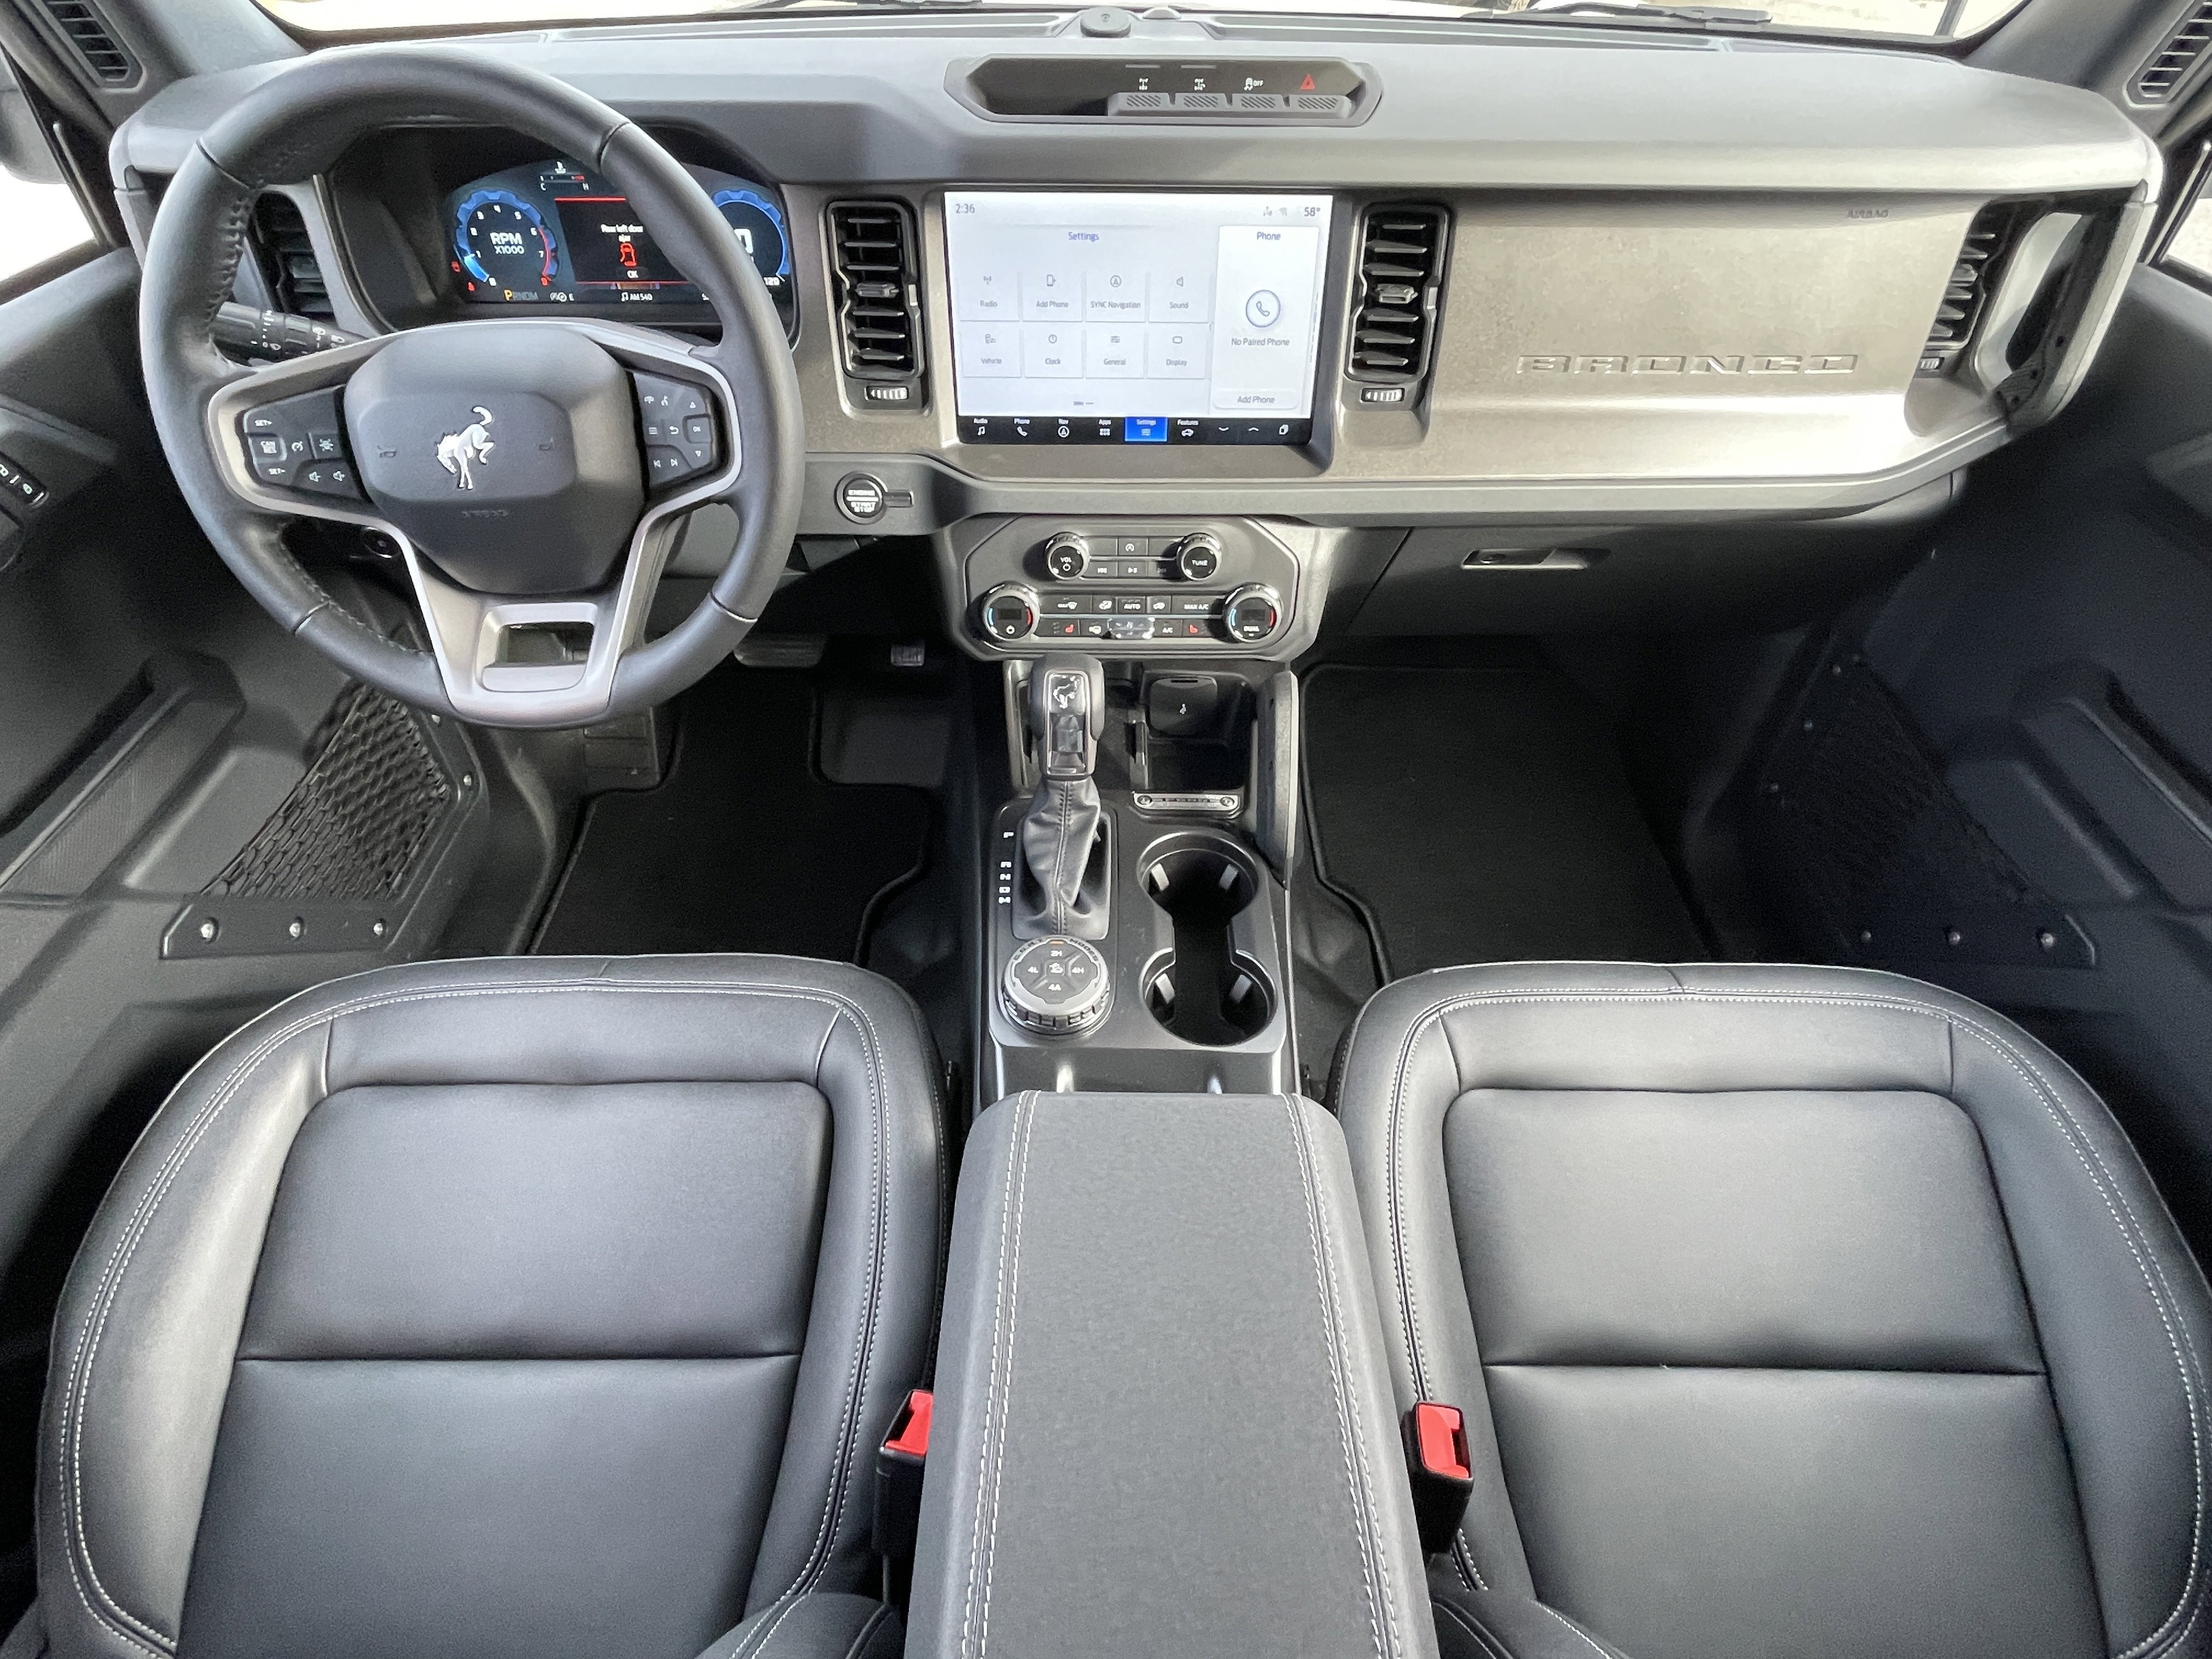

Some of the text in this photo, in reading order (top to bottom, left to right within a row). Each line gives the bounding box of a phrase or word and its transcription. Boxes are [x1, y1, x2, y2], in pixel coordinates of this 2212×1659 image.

[956, 204, 975, 213] 2:36
[490, 232, 523, 245] RPM
[1068, 232, 1099, 242] Settings
[1256, 232, 1281, 240] Phone
[494, 245, 524, 255] X1000
[1108, 301, 1141, 309] Navigation
[1267, 338, 1290, 346] Phone
[1103, 358, 1126, 366] General
[1166, 358, 1187, 367] Display
[1515, 354, 1858, 375] BRONCO
[1252, 396, 1275, 404] Phone
